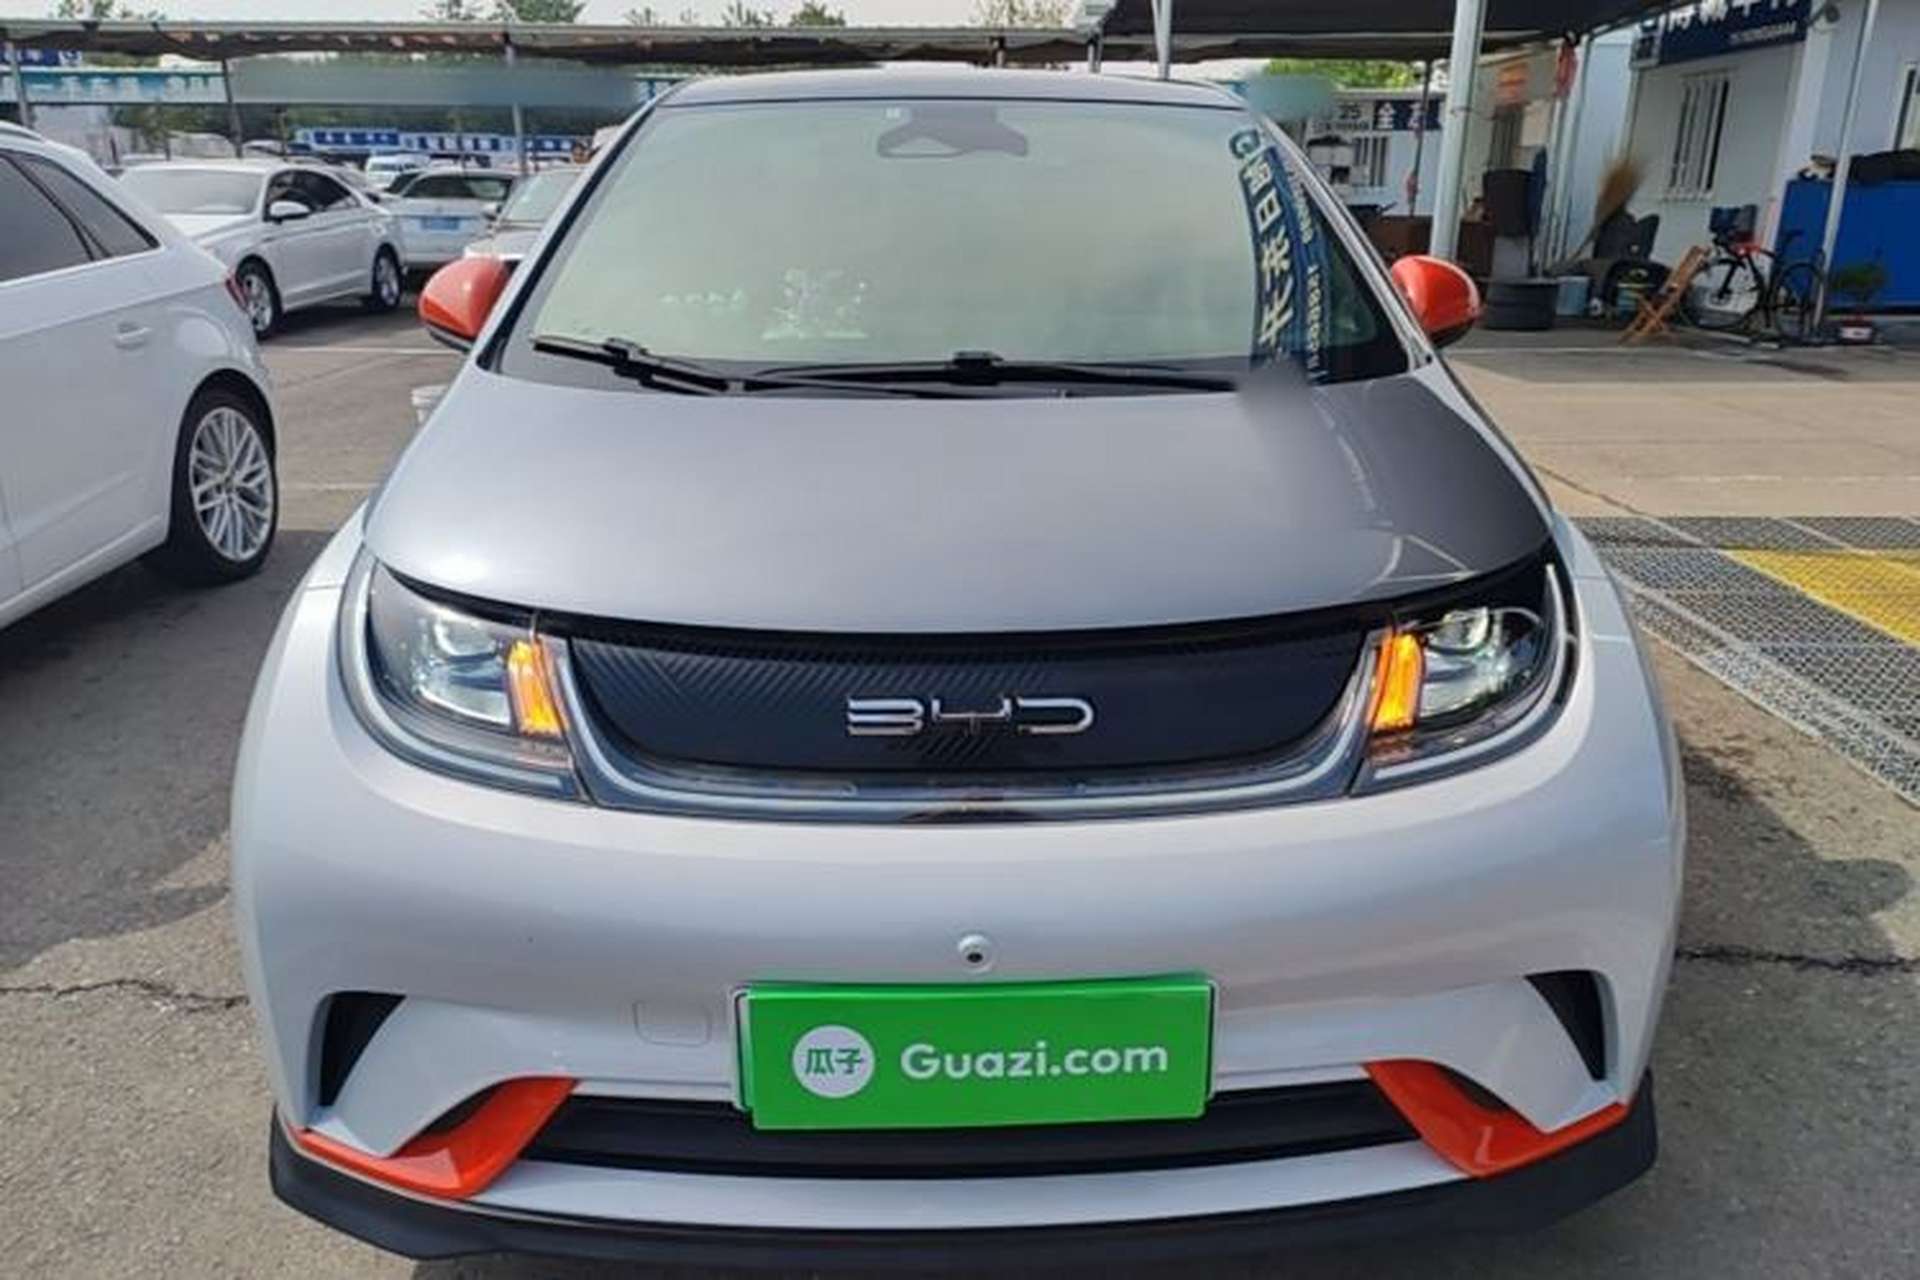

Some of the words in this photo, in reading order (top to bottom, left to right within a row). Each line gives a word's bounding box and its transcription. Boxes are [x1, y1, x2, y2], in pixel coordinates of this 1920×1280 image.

[847, 698, 1094, 736] BYD
[804, 1047, 864, 1075] 瓜子
[900, 1040, 1169, 1080] Guazi.com
